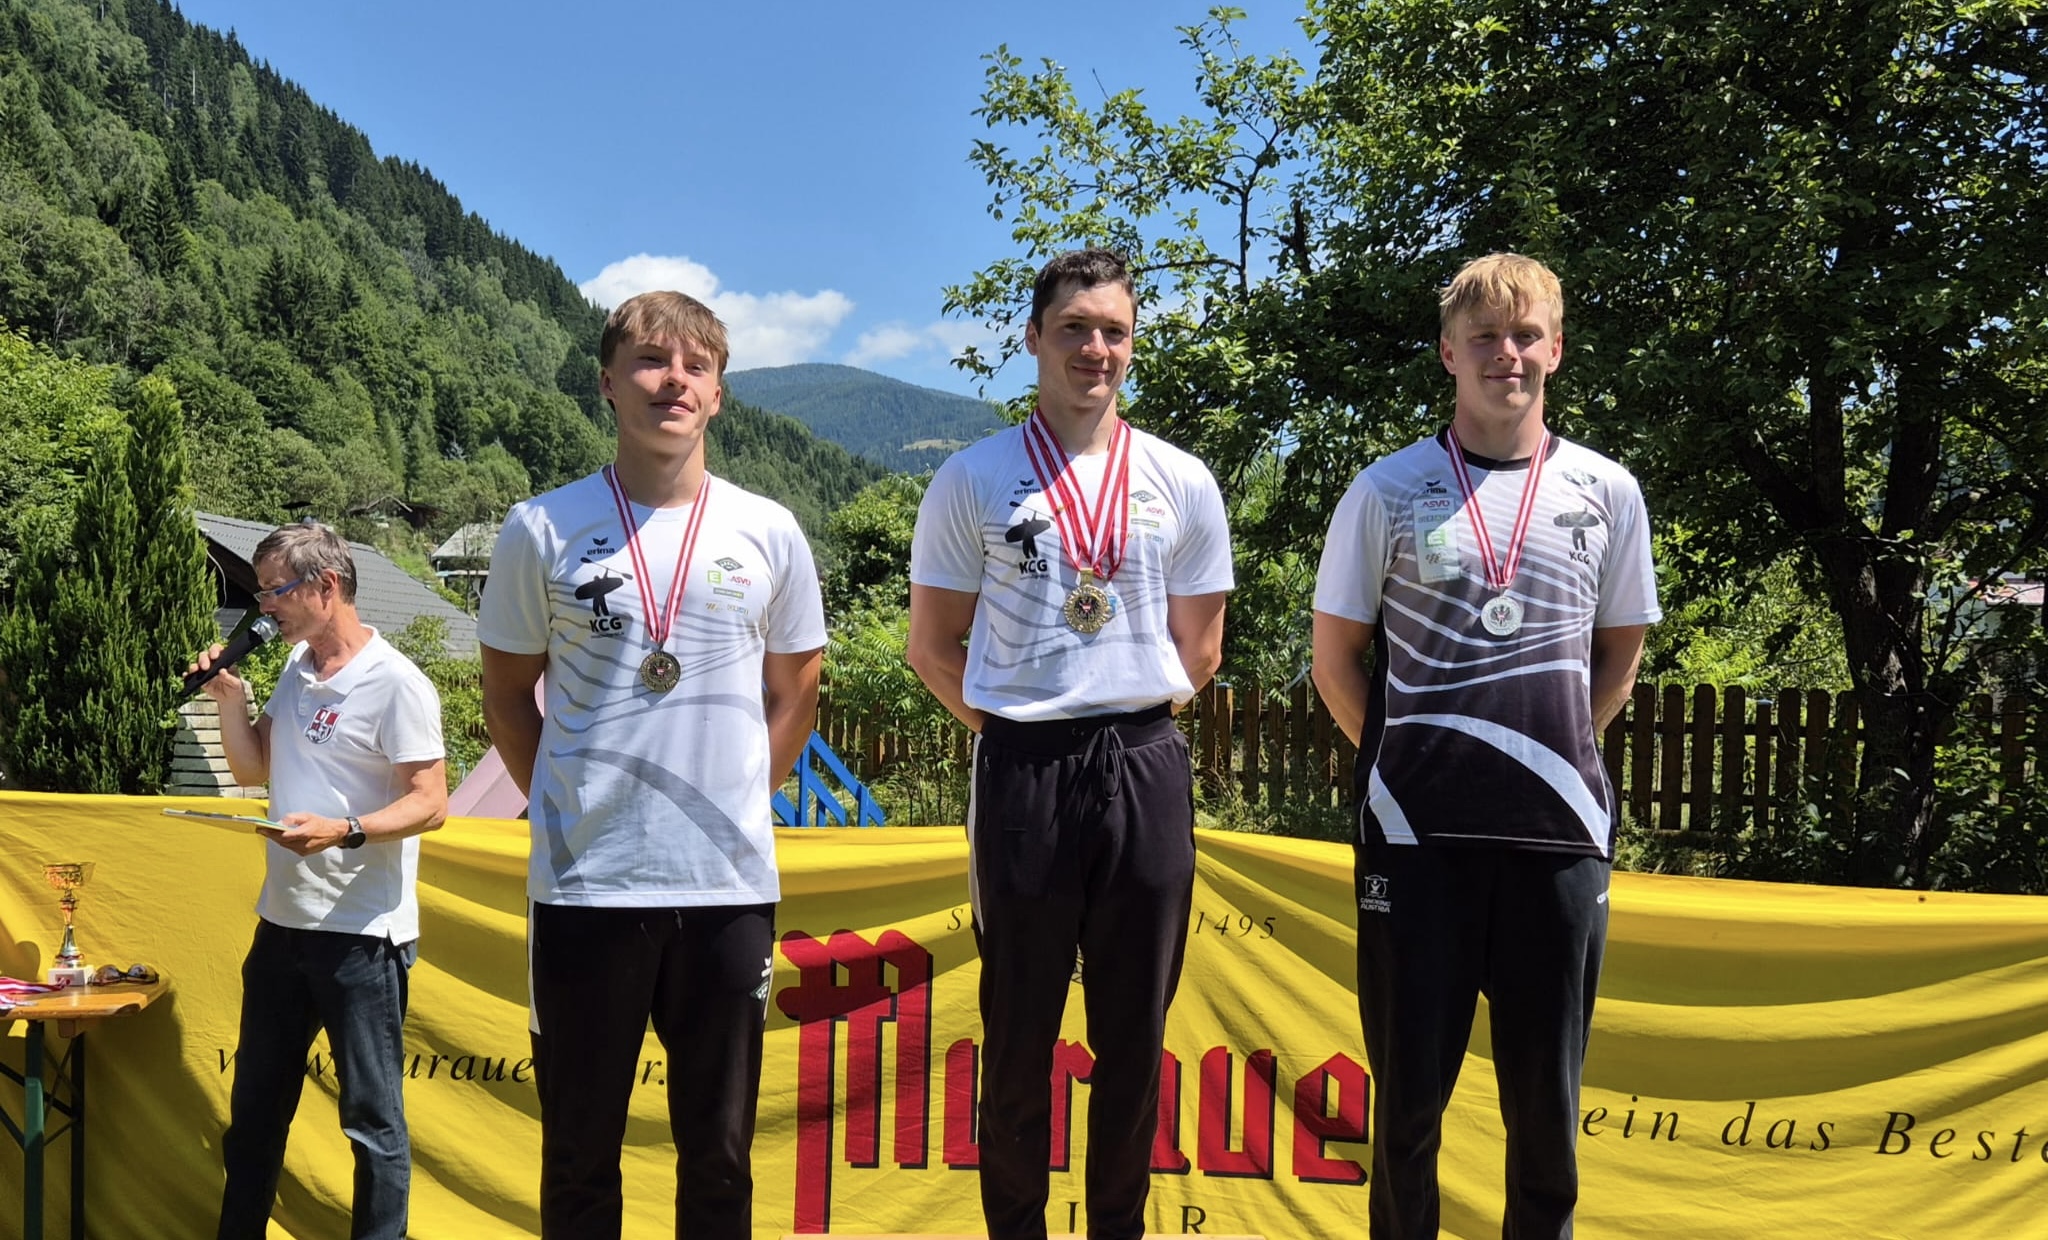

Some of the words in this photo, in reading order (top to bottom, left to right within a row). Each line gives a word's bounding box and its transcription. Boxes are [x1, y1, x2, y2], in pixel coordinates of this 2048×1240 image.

[587, 547, 615, 555] erima
[1569, 550, 1590, 564] KCG
[1019, 559, 1048, 574] KCG
[589, 617, 622, 633] KCG
[1193, 910, 1276, 940] 1495
[1582, 1095, 1681, 1142] ein
[1721, 1101, 1835, 1152] das
[1875, 1110, 2048, 1163] Best
